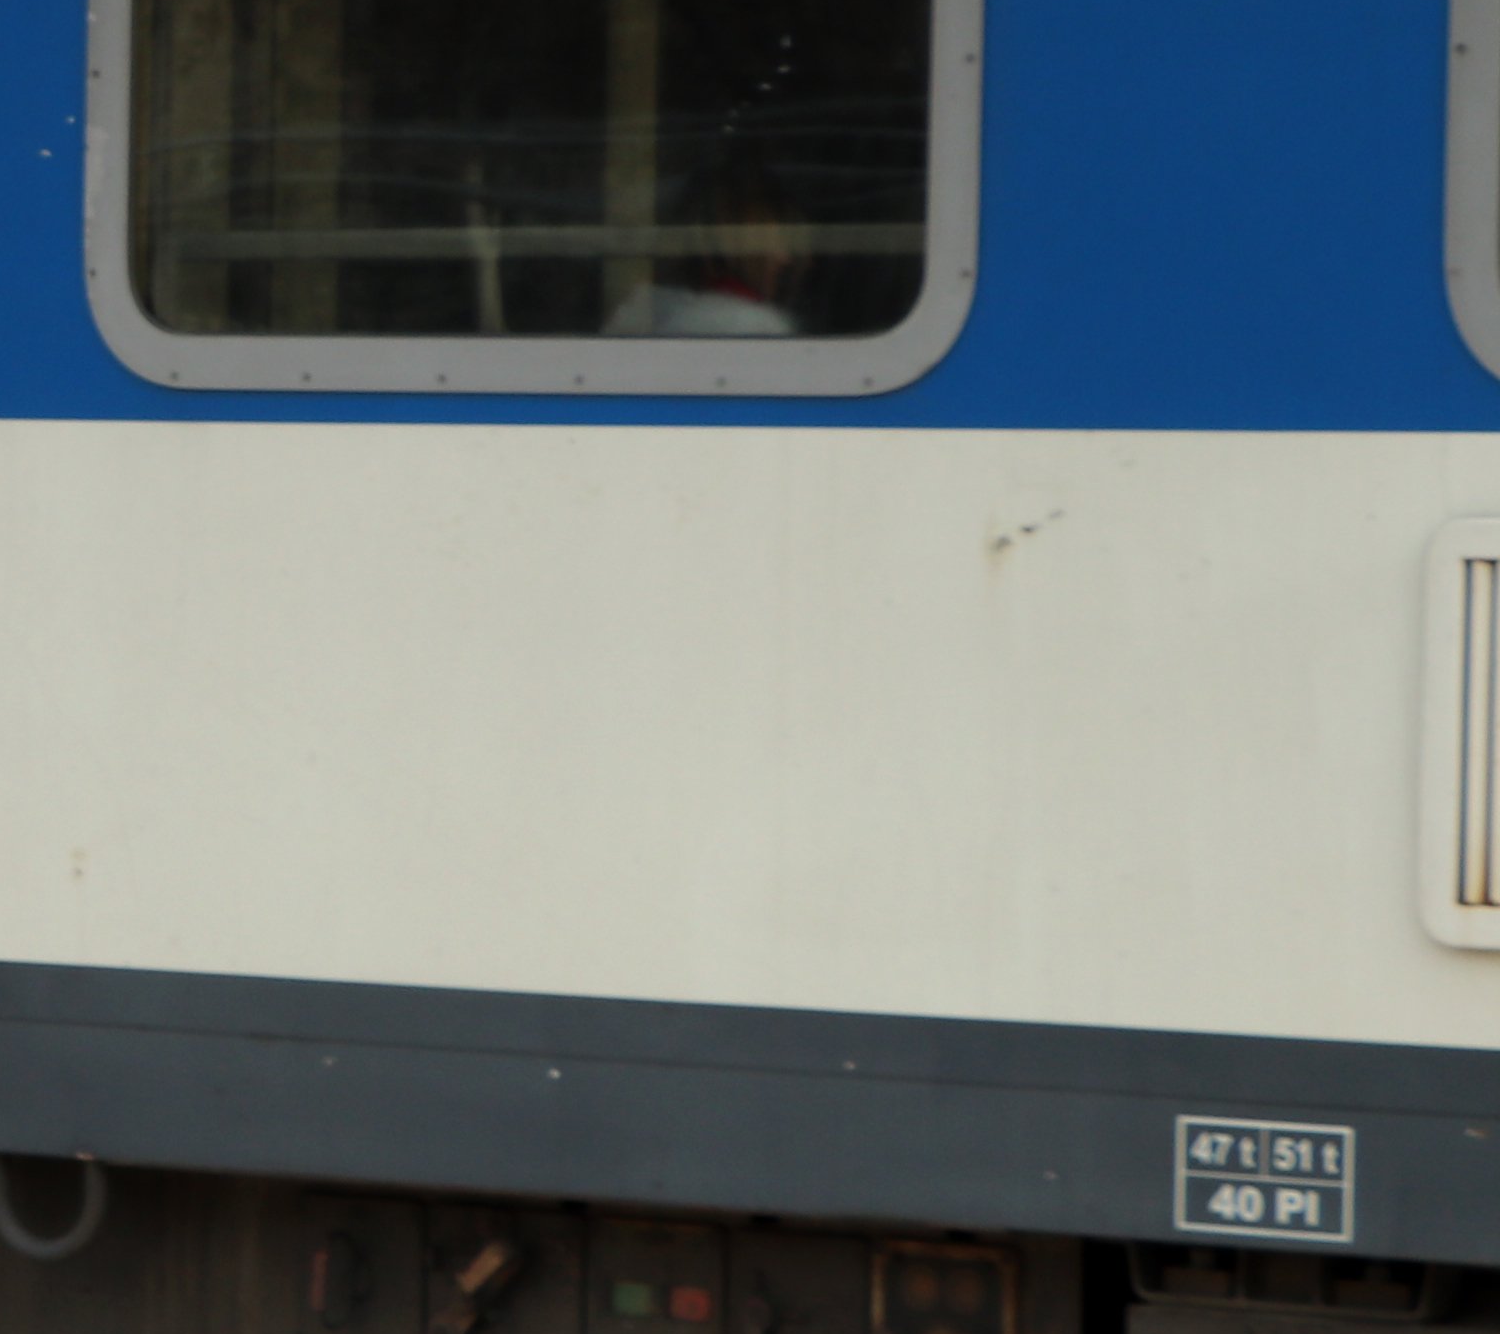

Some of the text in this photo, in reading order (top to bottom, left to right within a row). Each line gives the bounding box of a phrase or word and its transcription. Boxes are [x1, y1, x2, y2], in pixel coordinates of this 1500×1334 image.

[1189, 1131, 1257, 1169] 47 t
[1272, 1137, 1341, 1175] 51 t
[1207, 1183, 1264, 1223] 40
